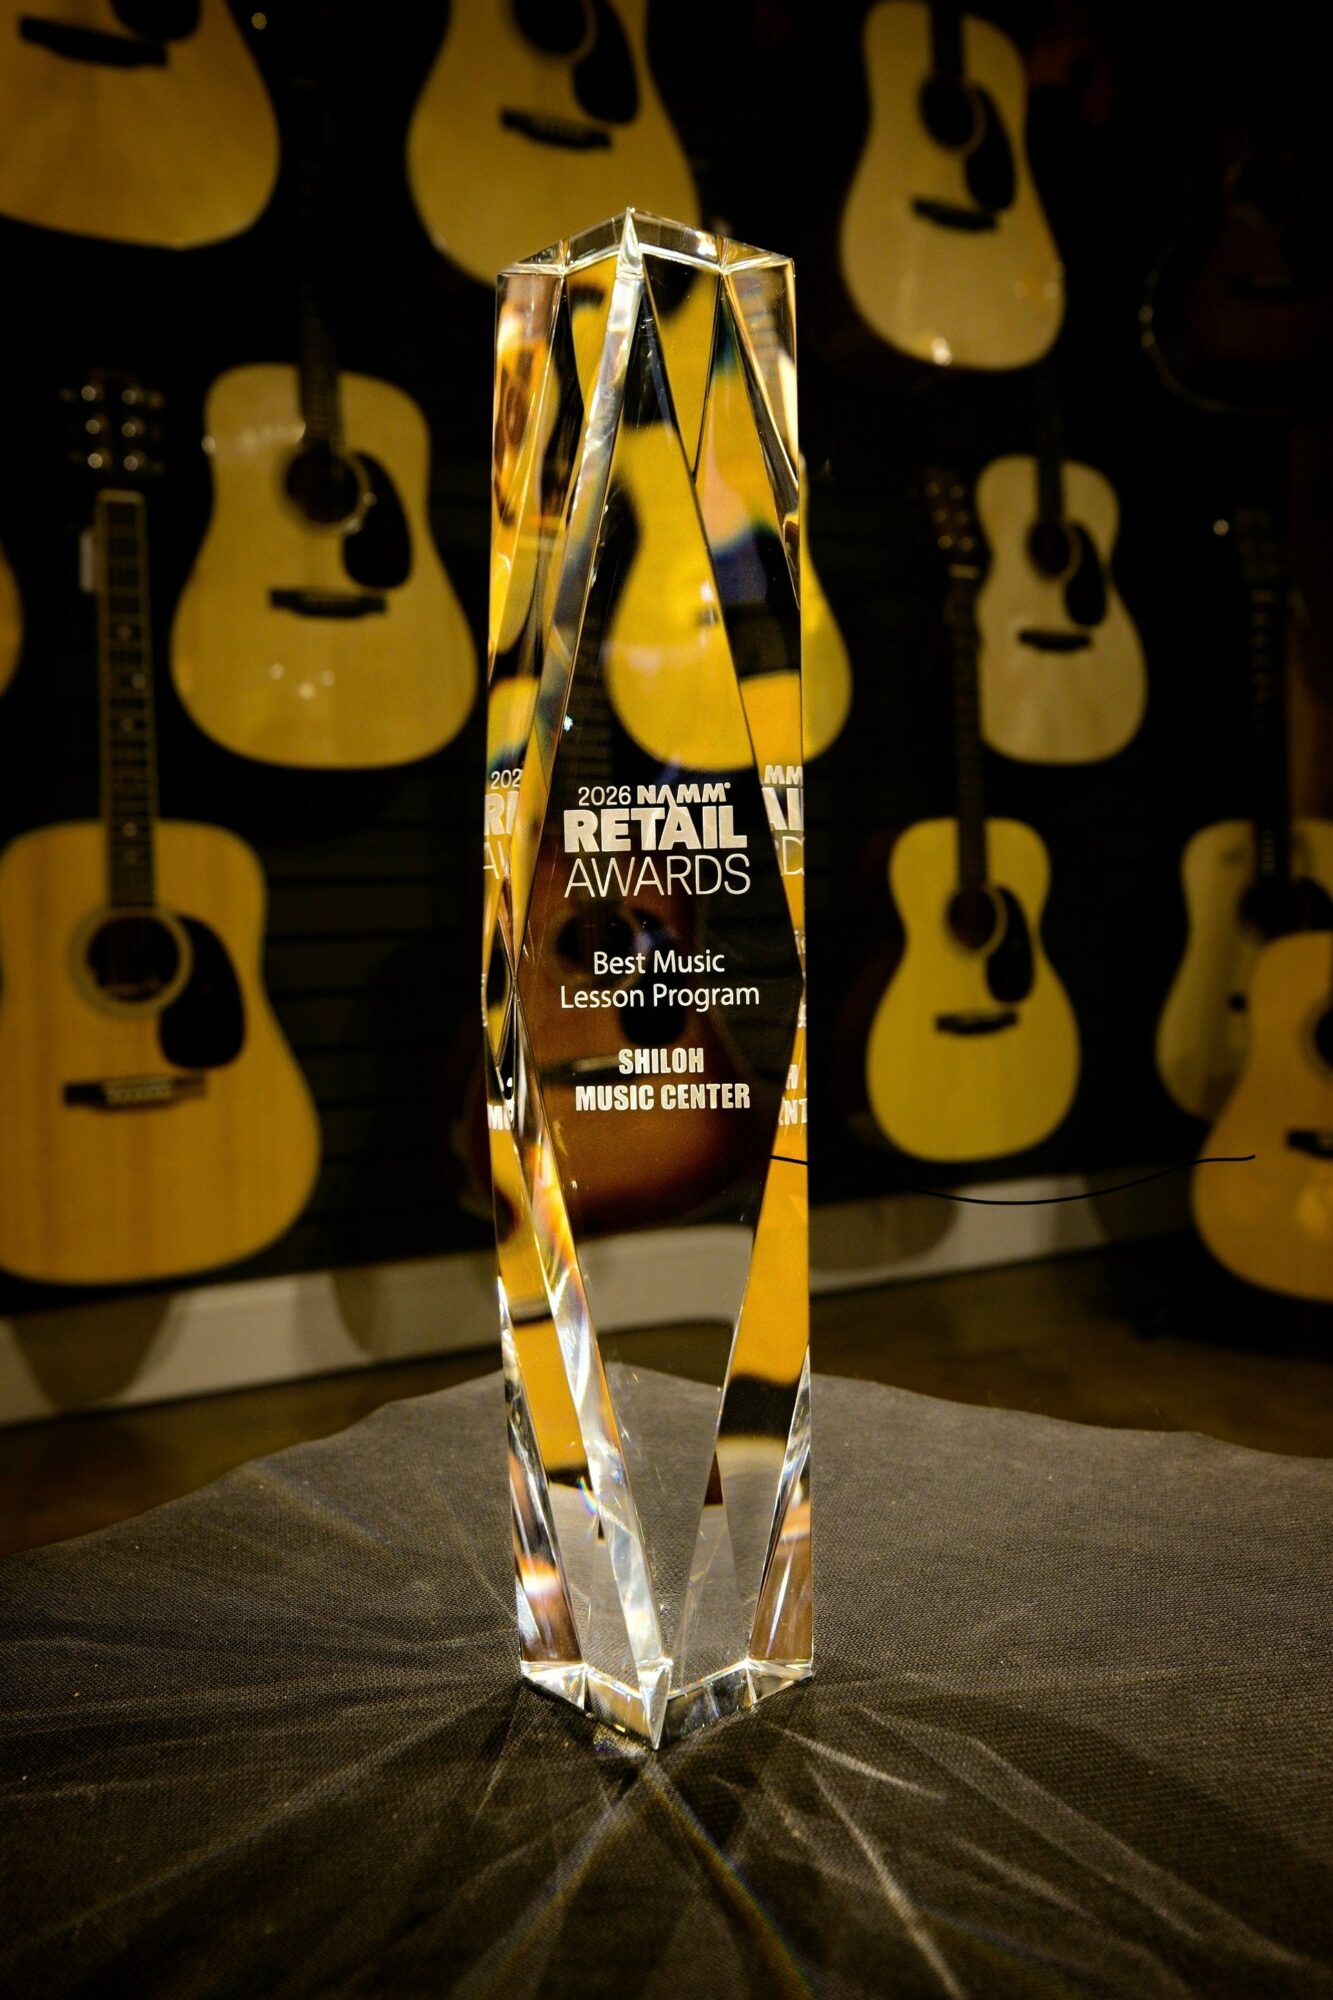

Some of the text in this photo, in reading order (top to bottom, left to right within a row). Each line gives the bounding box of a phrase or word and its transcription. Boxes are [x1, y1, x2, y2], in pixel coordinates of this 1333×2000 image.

[578, 785, 632, 806] 2026
[563, 804, 748, 853] RETAIL
[564, 853, 751, 898] AWARDS
[593, 949, 725, 975] Best Music
[560, 983, 760, 1013] Lesson Program
[618, 1047, 705, 1075] SHILOH
[575, 1083, 751, 1111] MUSIC CENTER
